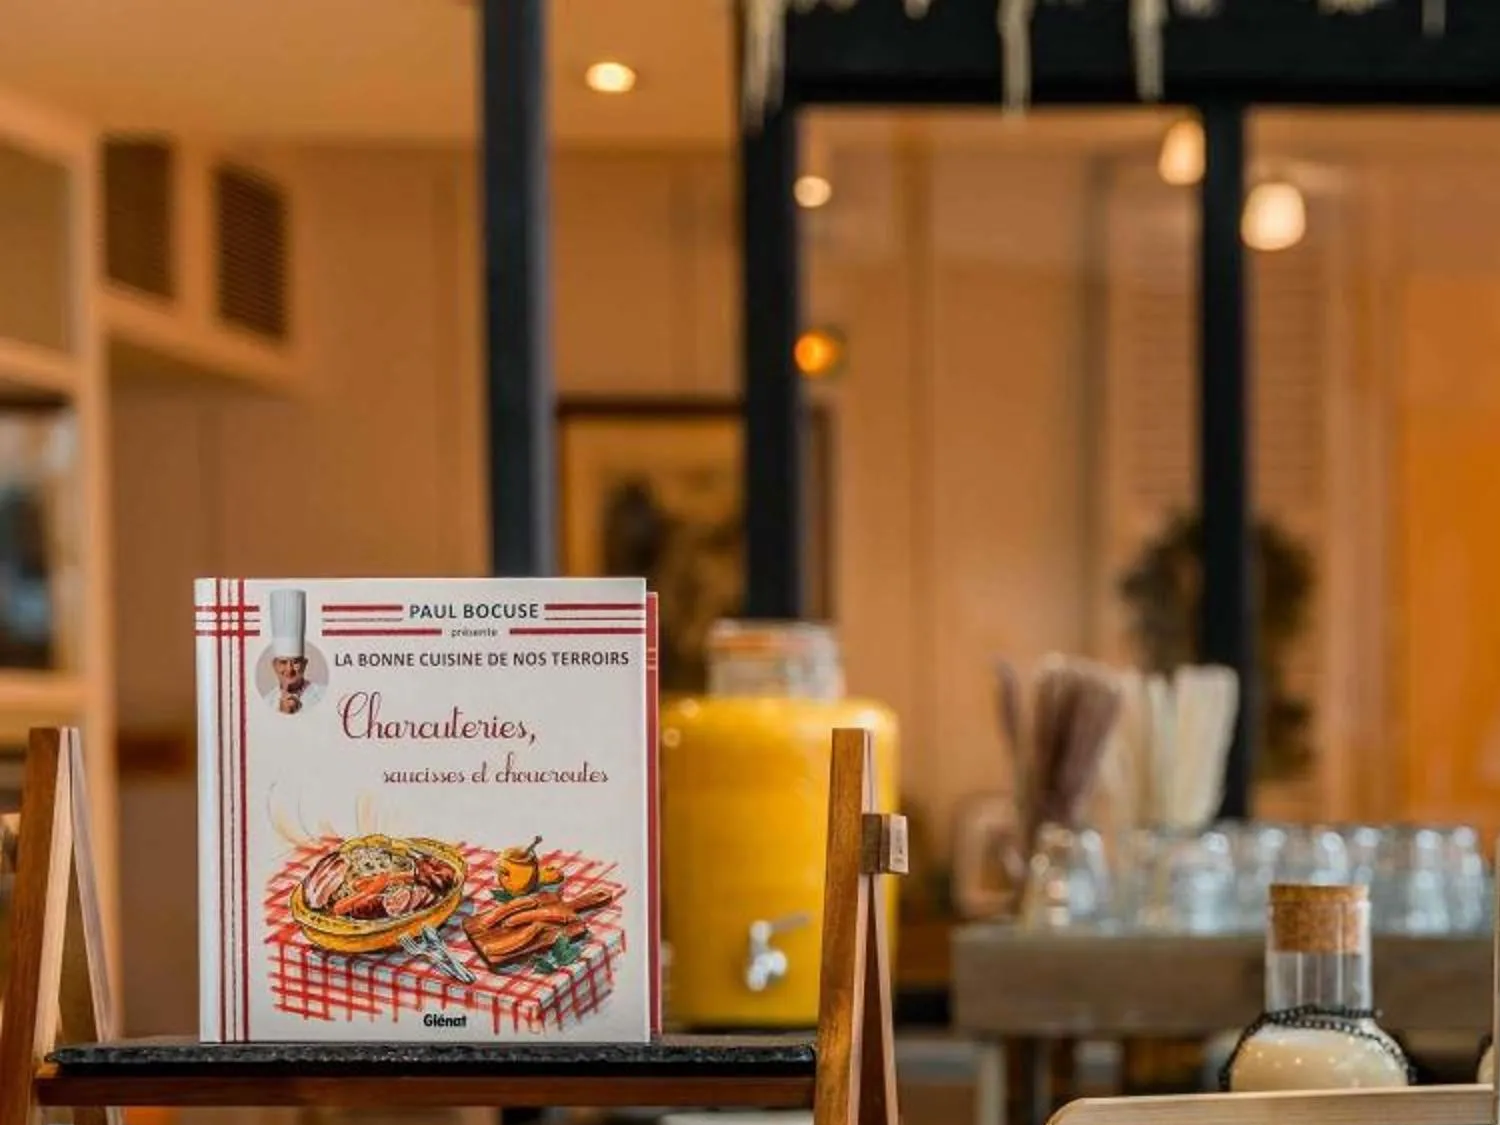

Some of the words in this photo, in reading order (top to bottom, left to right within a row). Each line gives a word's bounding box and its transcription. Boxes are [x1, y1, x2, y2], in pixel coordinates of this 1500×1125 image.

[409, 603, 457, 619] PAUL
[463, 603, 539, 619] BOCUSE
[335, 653, 353, 667] LA
[358, 653, 414, 667] BONNE
[419, 652, 483, 667] CUISINE
[488, 652, 507, 667] DE
[513, 652, 547, 666] NOS
[552, 651, 629, 666] TERROIRS
[336, 691, 536, 747] Charcuteries,
[383, 767, 465, 783] saucisses
[471, 761, 488, 783] et
[495, 751, 608, 783] choucroutes
[423, 1014, 467, 1027] Glénat
